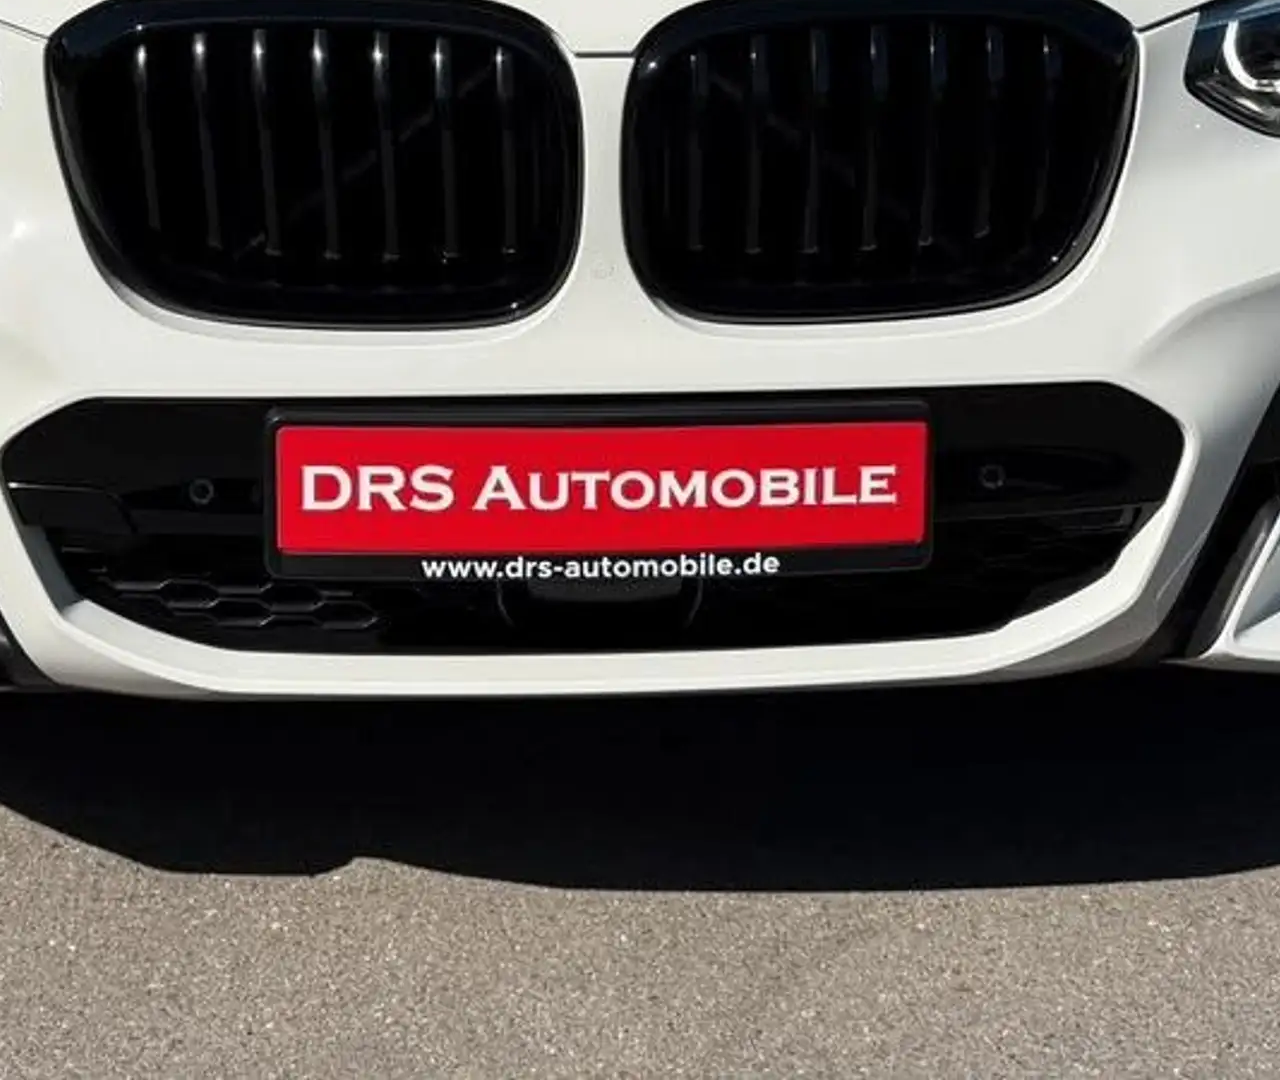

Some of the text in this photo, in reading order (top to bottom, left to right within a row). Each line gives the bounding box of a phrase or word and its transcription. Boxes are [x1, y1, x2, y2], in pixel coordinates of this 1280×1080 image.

[301, 464, 898, 512] DRS AUTOMOBILE
[421, 550, 782, 580] www.drs-automobile.de
